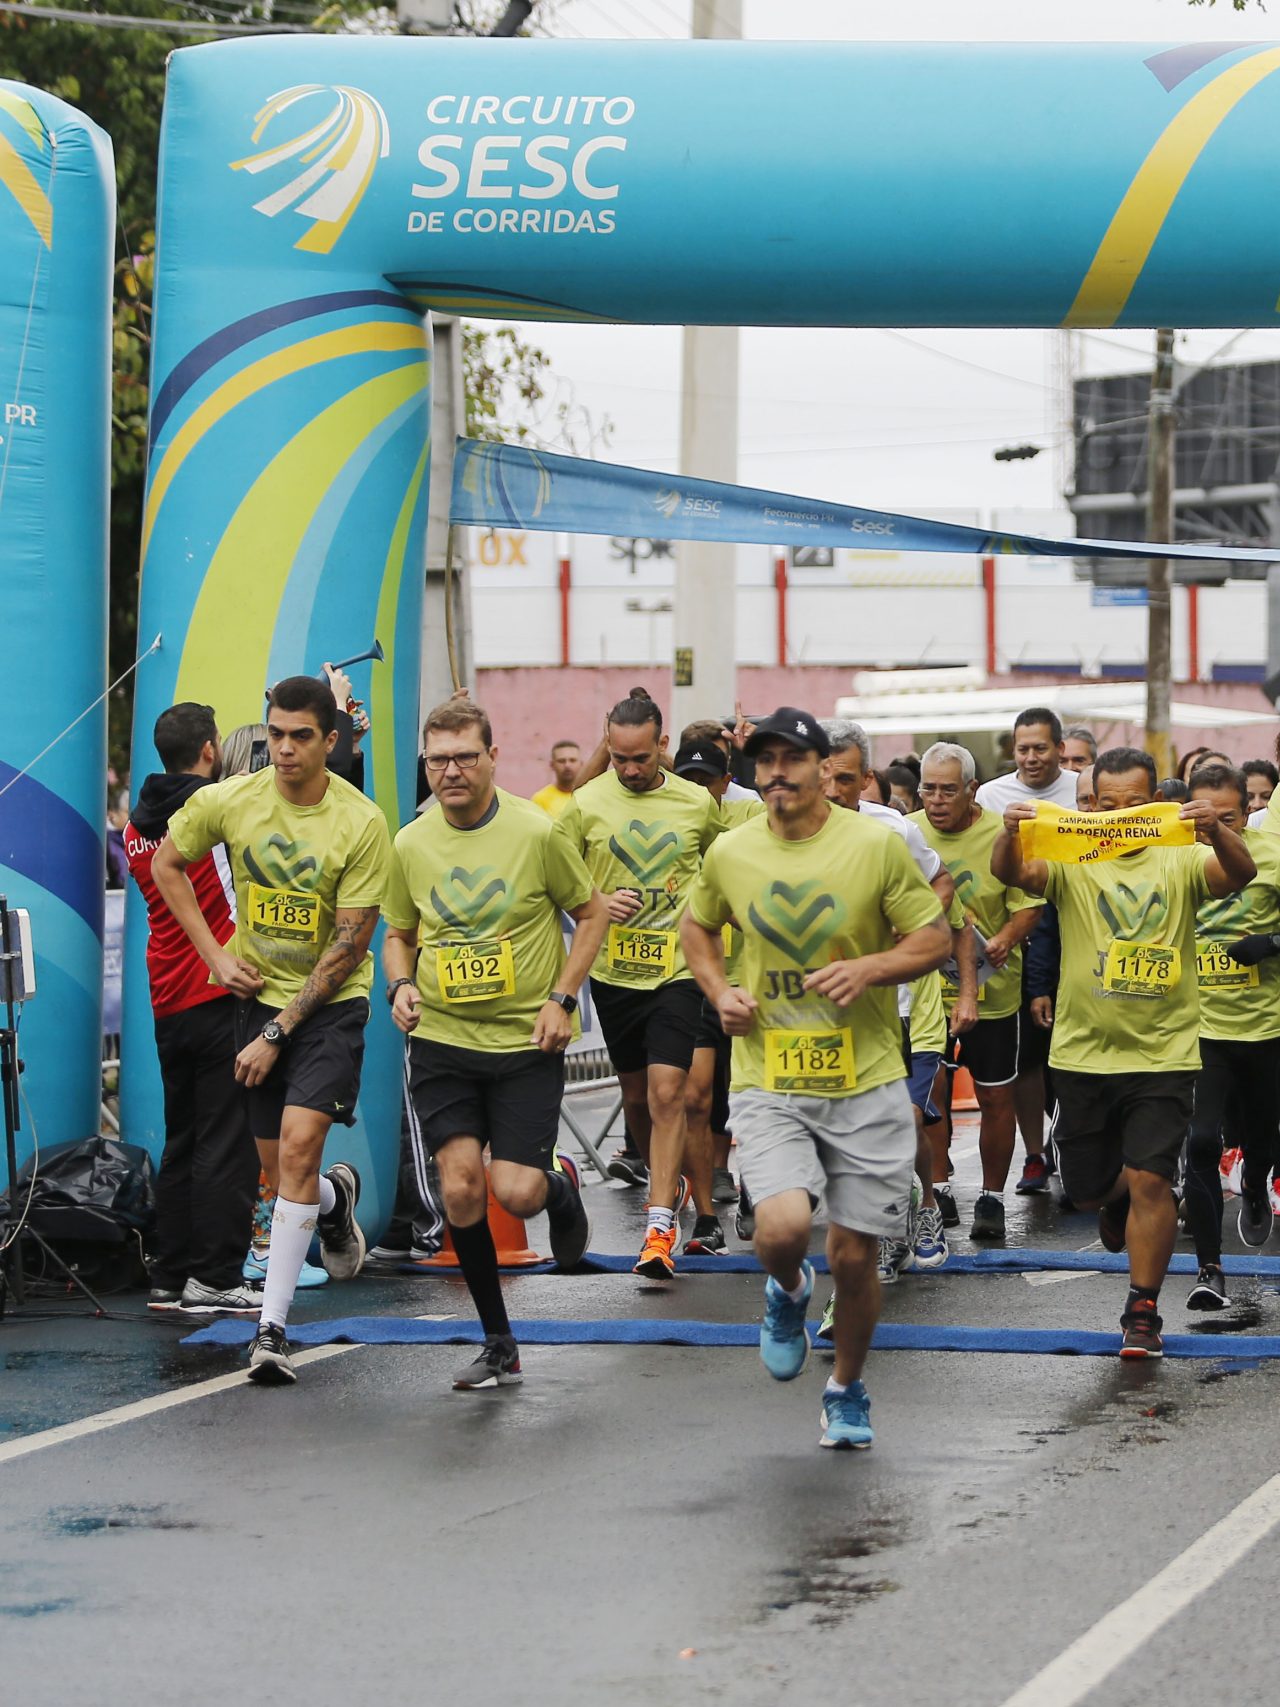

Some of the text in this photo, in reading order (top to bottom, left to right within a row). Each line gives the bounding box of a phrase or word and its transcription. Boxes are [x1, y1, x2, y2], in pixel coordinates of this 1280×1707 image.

[426, 95, 636, 126] CIRCUITO
[411, 134, 628, 200] SESC
[407, 208, 617, 234] DE CORRIDAS
[5, 403, 37, 427] PR
[1058, 816, 1104, 826] CAMPANHA
[1105, 816, 1116, 826] DE
[1125, 827, 1162, 838] RENAL
[257, 902, 311, 925] 1183
[617, 941, 663, 961] 1184
[445, 958, 500, 981] 1192
[1117, 957, 1169, 979] 1178
[778, 1049, 841, 1071] 1182
